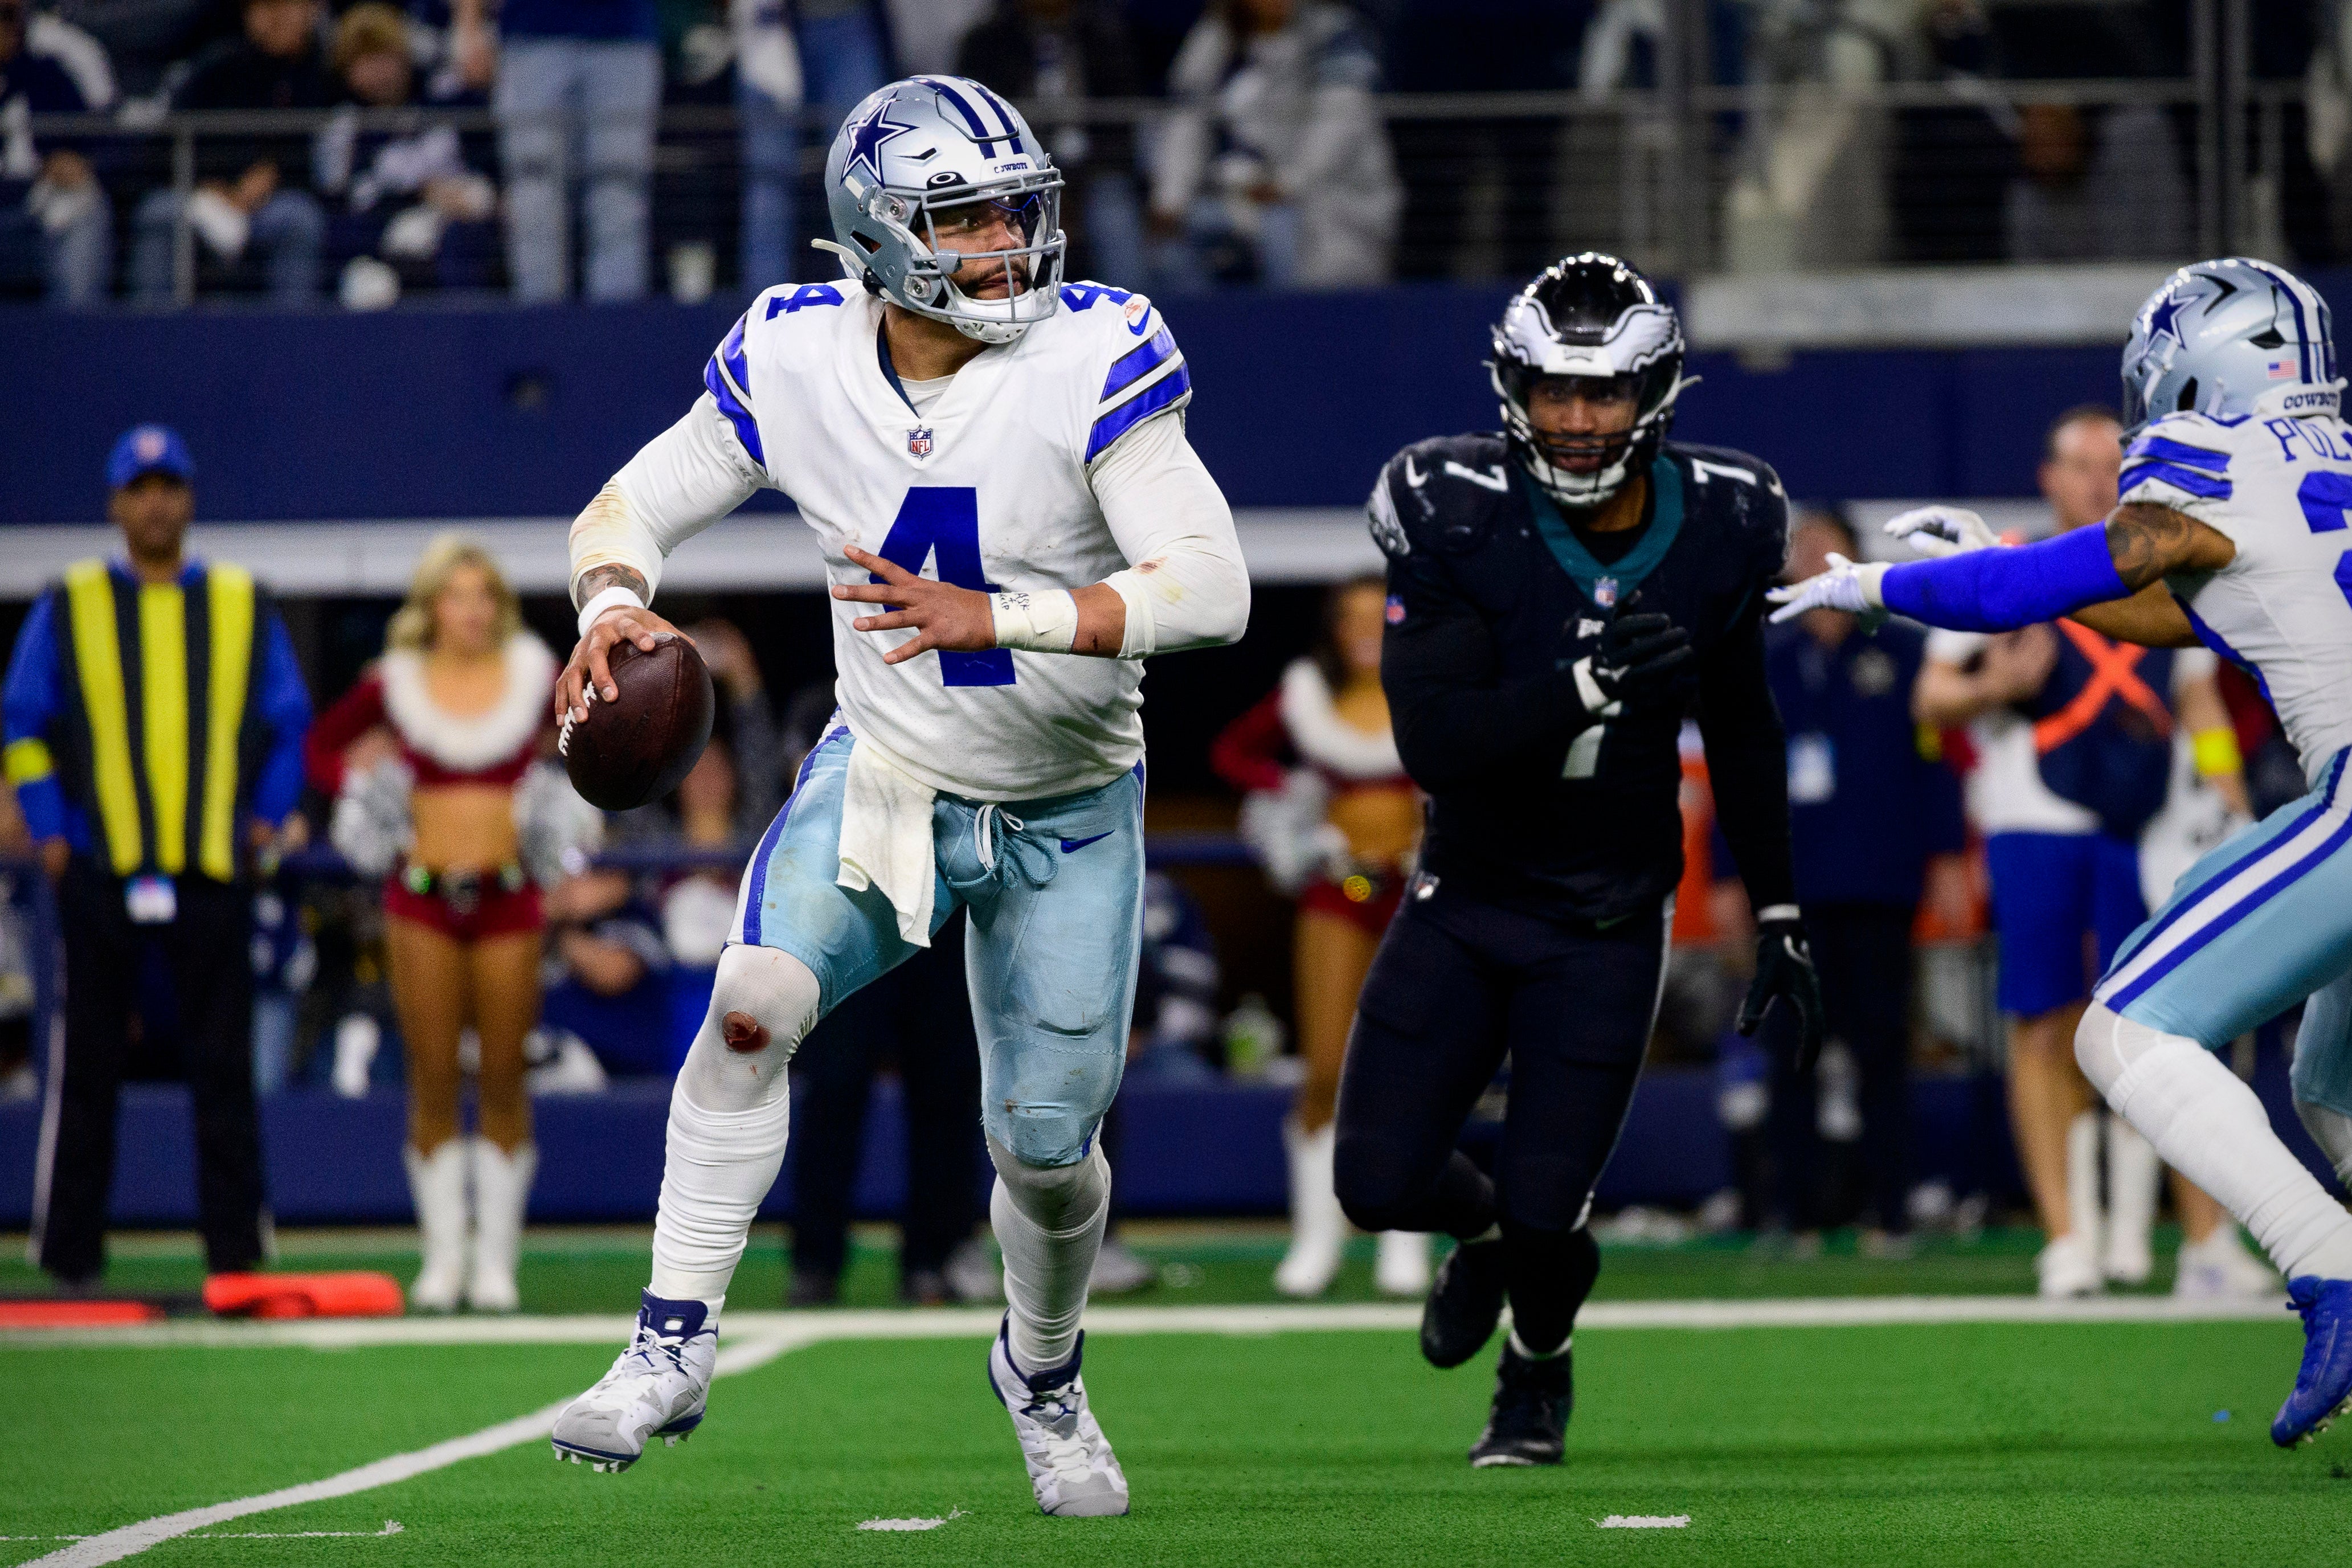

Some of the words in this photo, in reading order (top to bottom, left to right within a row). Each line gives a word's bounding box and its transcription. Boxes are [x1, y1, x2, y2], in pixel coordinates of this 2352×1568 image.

[766, 284, 845, 322] 4
[1059, 284, 1134, 313] 4
[911, 440, 929, 453] NFL
[2263, 417, 2352, 462] POL
[1444, 460, 1508, 493] 7
[1691, 457, 1758, 486] 7
[869, 486, 1017, 687] 4
